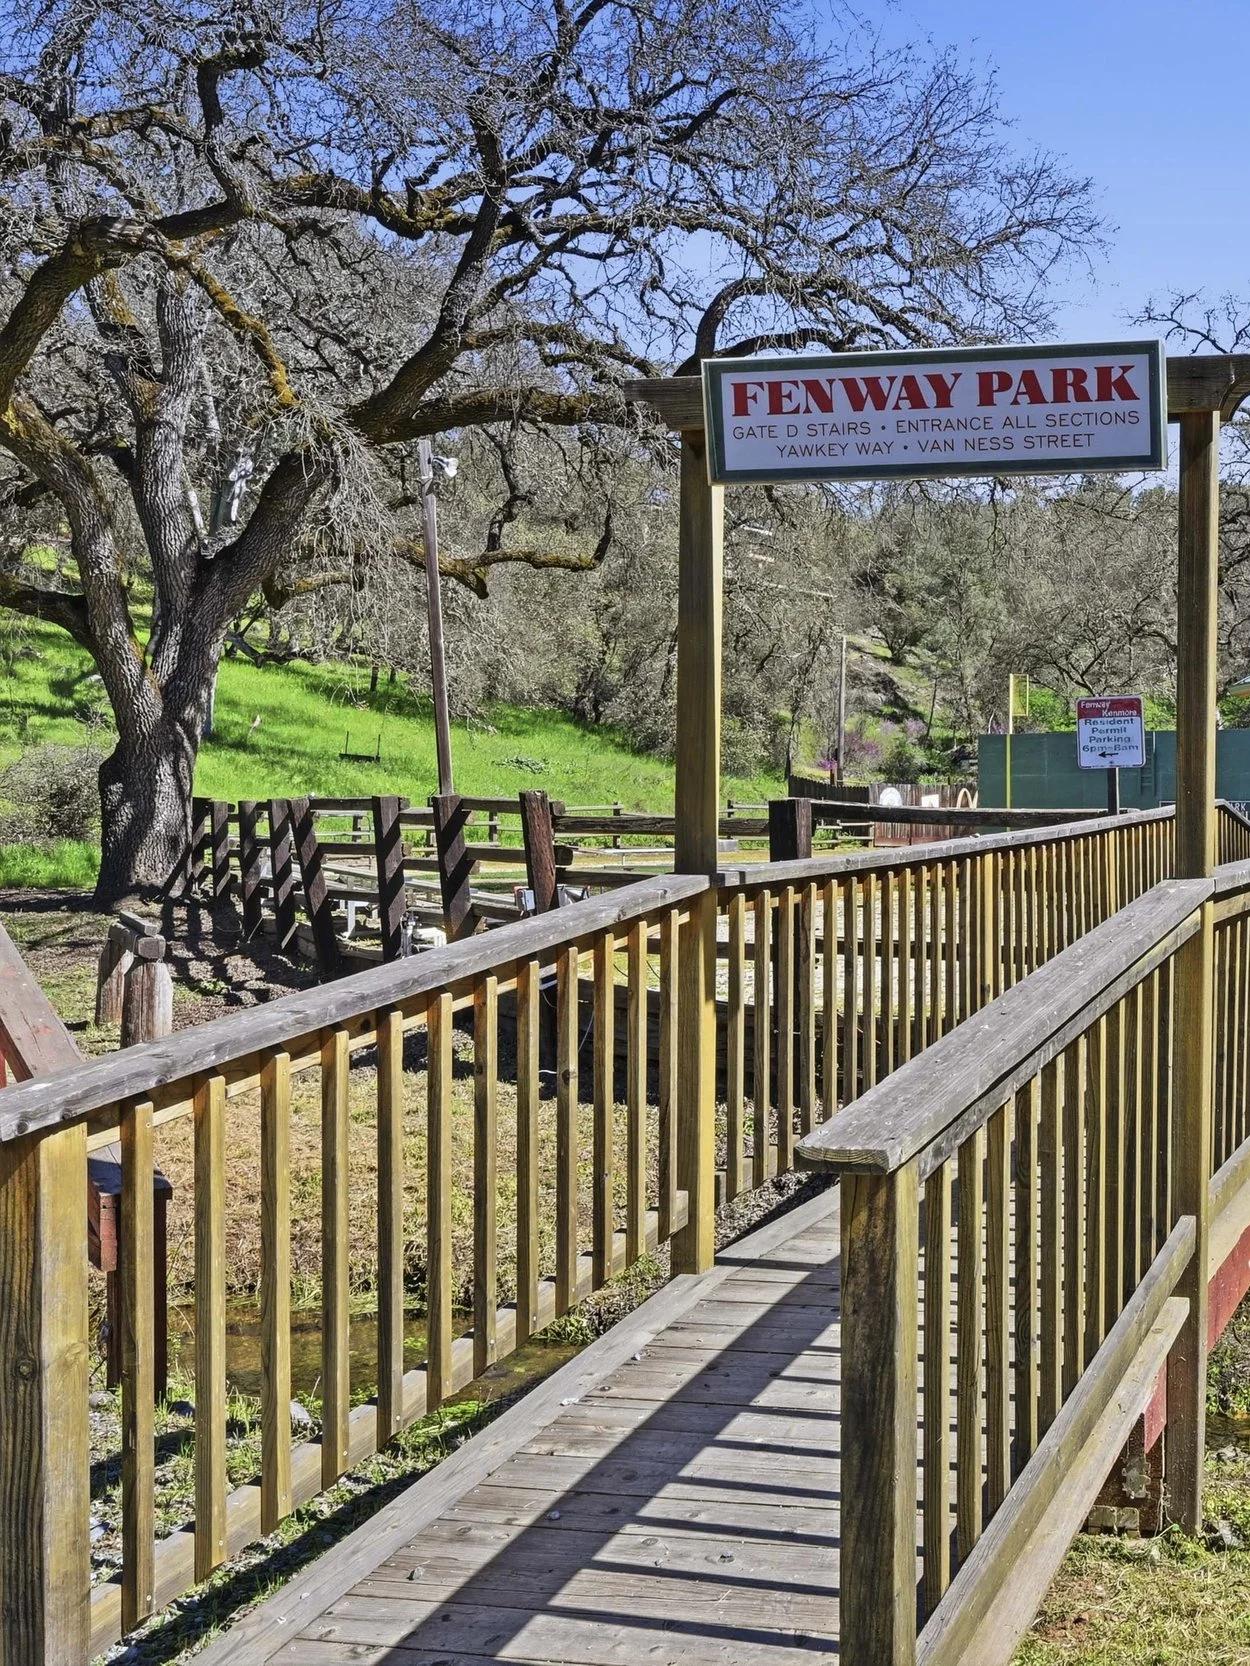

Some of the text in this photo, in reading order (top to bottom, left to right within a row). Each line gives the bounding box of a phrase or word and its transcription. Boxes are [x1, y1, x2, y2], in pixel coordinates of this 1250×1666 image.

[731, 364, 1140, 417] FENWAY PARK
[732, 410, 1140, 440] GATE D STAIRS ENTRANCE ALL SECTIONS
[776, 433, 1095, 459] YAWKEY WAY VAN NESS STREET
[1102, 709, 1137, 717] Kenmore
[1084, 718, 1134, 726] Resident
[1091, 727, 1127, 735] Permit
[1088, 736, 1131, 744] Parking
